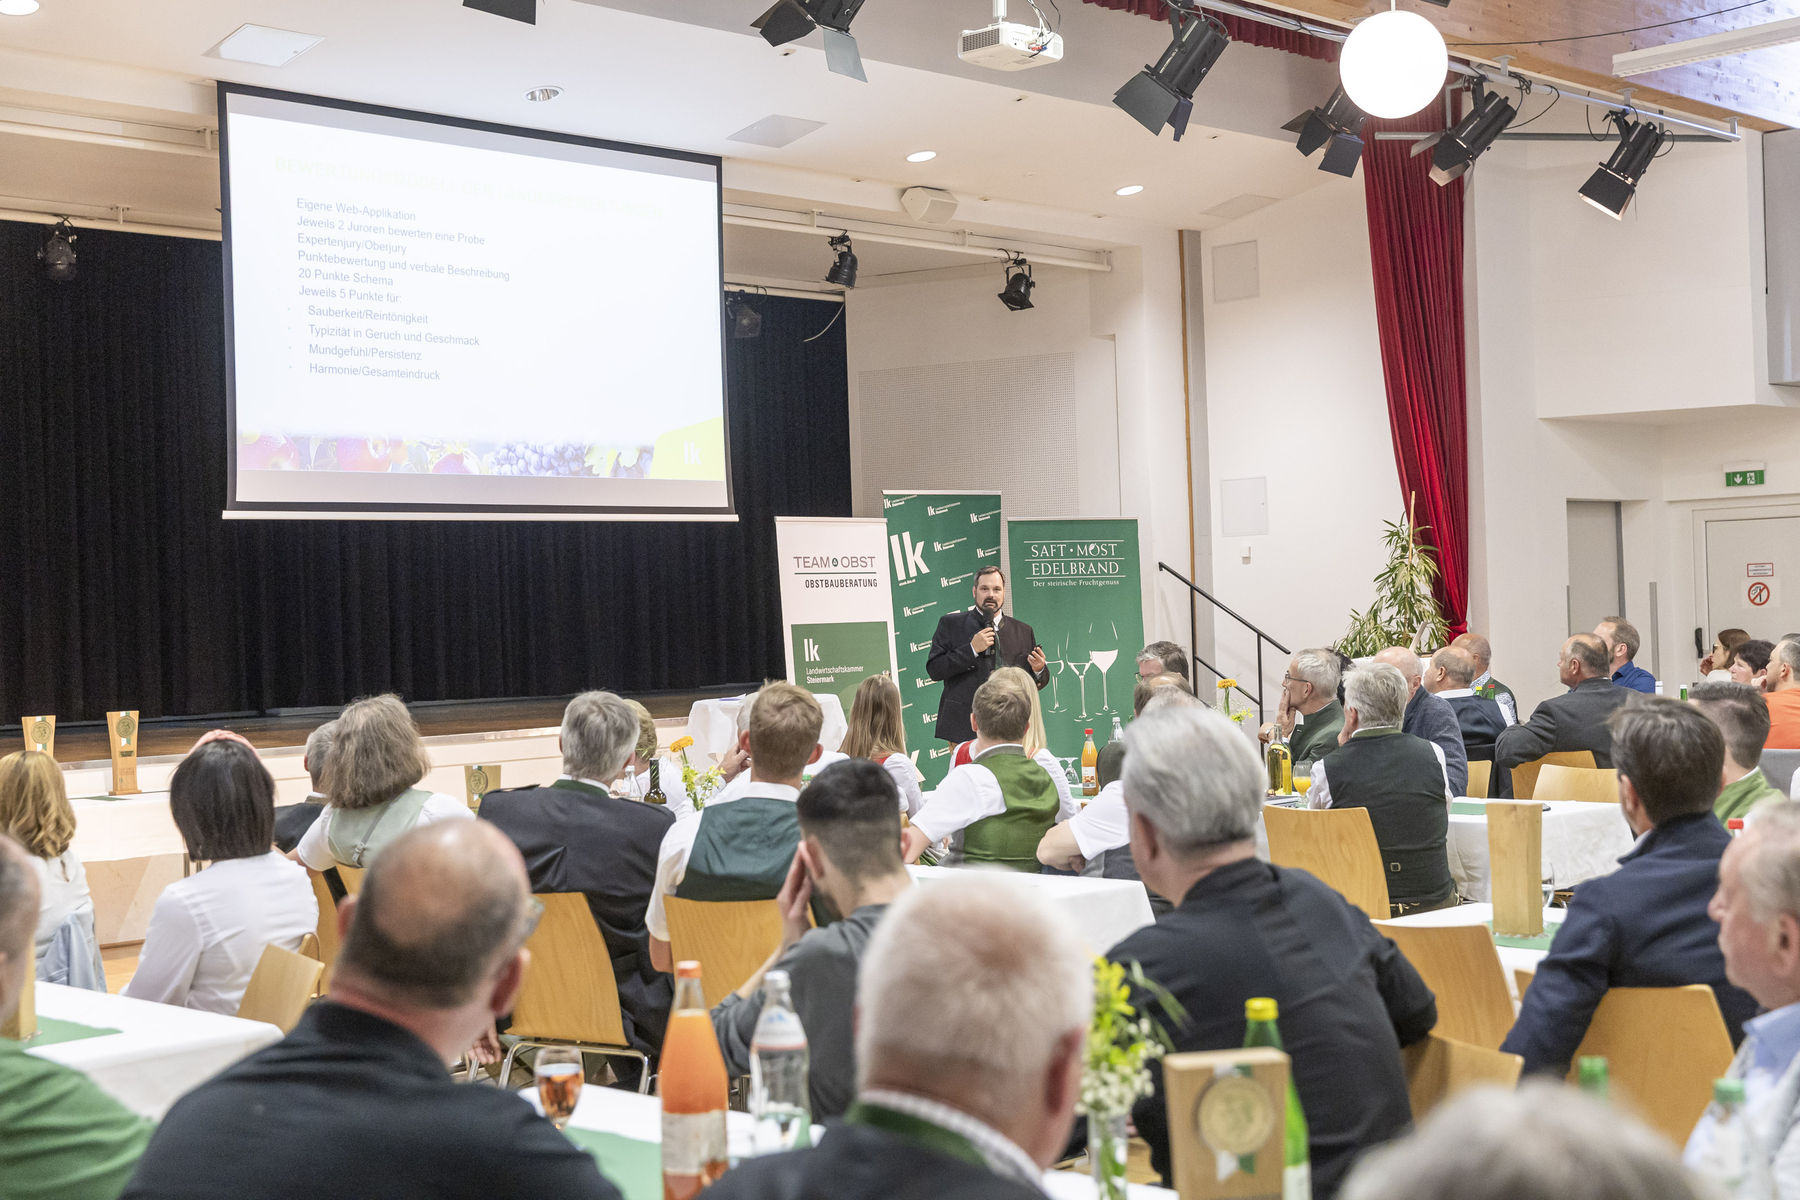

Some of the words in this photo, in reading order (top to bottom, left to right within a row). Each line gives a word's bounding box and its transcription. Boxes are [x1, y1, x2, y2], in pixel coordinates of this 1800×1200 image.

[296, 198, 333, 212] Eigene
[335, 202, 416, 222] Web-Applikation
[297, 216, 335, 230] Jeweils
[338, 220, 345, 230] 2
[347, 221, 385, 235] Juroren
[388, 225, 433, 241] bewerten
[435, 230, 455, 242] eine
[458, 232, 486, 246] Probe
[297, 233, 408, 256] Expertenjury/Oberjury
[298, 250, 386, 271] Punktebewertung
[389, 260, 407, 271] und
[409, 262, 445, 274] verbale
[447, 264, 511, 282] Beschreibung
[298, 268, 312, 279] 20
[314, 269, 350, 282] Punkte
[353, 272, 394, 287] Schema
[298, 285, 337, 299] Jeweils
[339, 288, 346, 299] 5
[349, 289, 384, 303] Punkte
[309, 324, 351, 339] Typizität
[353, 327, 362, 338] in
[365, 328, 401, 341] Geruch
[404, 331, 422, 342] und
[424, 332, 480, 347] Geschmack
[309, 343, 422, 361] Mundgefühl/Persistenz
[309, 362, 441, 380] Harmonie/Gesamteindruck
[890, 531, 930, 581] lk
[1031, 544, 1067, 557] SAFT
[1076, 543, 1118, 557] MOST
[793, 556, 830, 568] TEAM
[840, 556, 876, 568] OBST
[1031, 561, 1119, 576] EDELBRAND
[805, 579, 878, 589] OBSTBAUBERATUNG
[1047, 579, 1077, 587] steirische
[1079, 579, 1120, 587] Fruchtgenuss
[804, 638, 820, 662] lk
